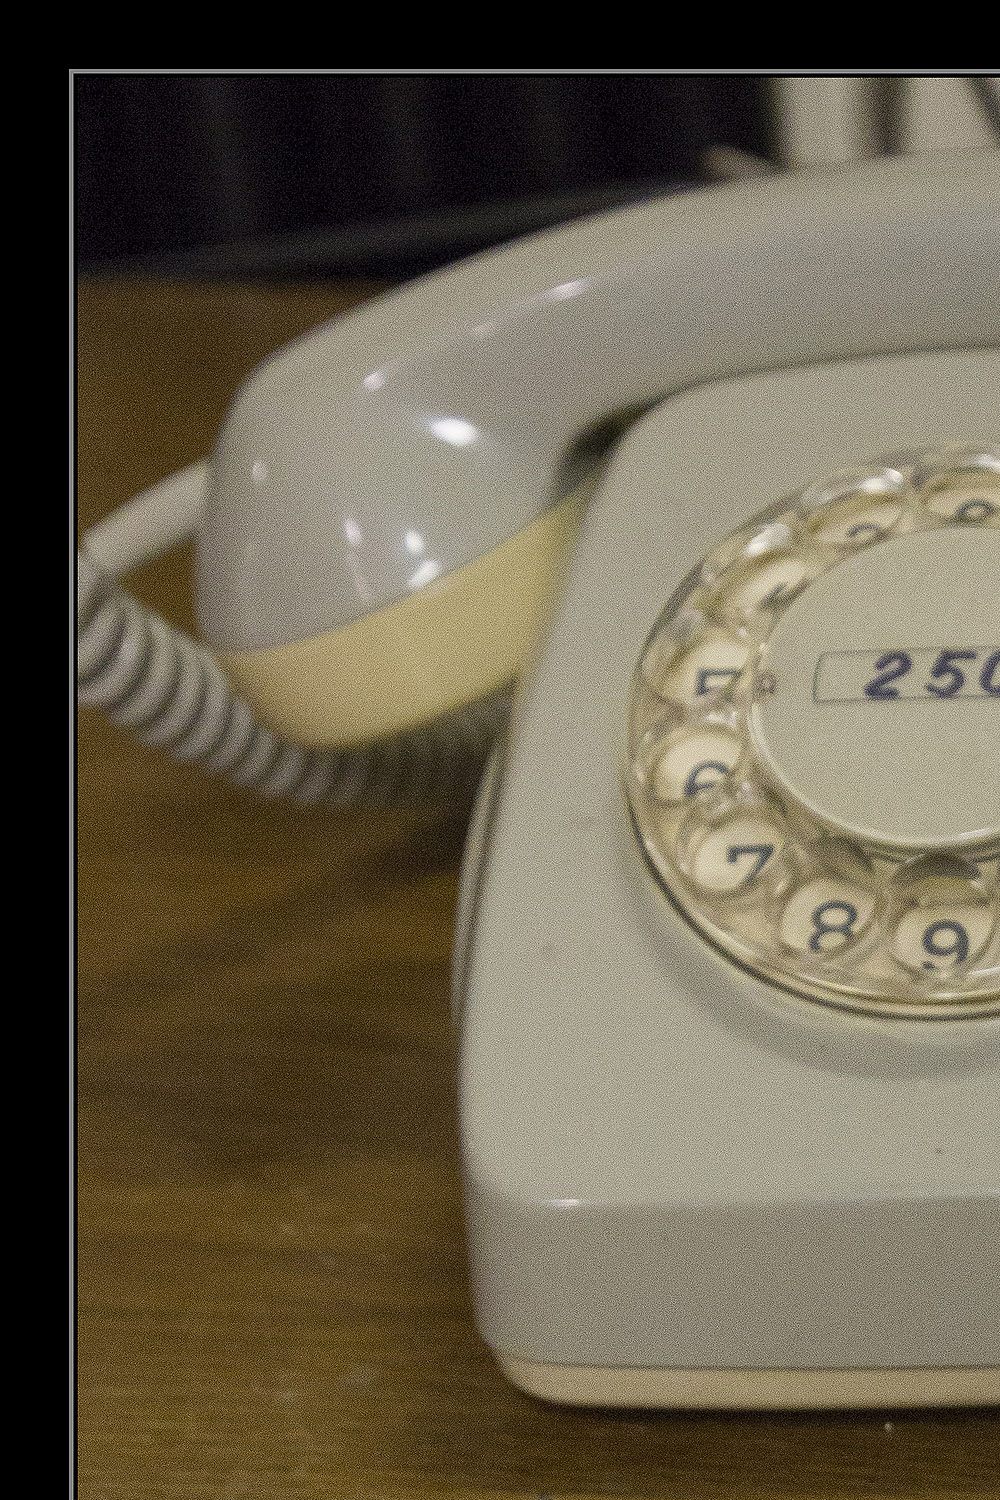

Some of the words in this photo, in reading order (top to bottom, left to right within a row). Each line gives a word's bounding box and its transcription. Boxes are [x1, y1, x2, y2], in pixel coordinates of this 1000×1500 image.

[726, 845, 775, 886] 7
[808, 900, 858, 952] 8
[921, 920, 970, 968] 9
